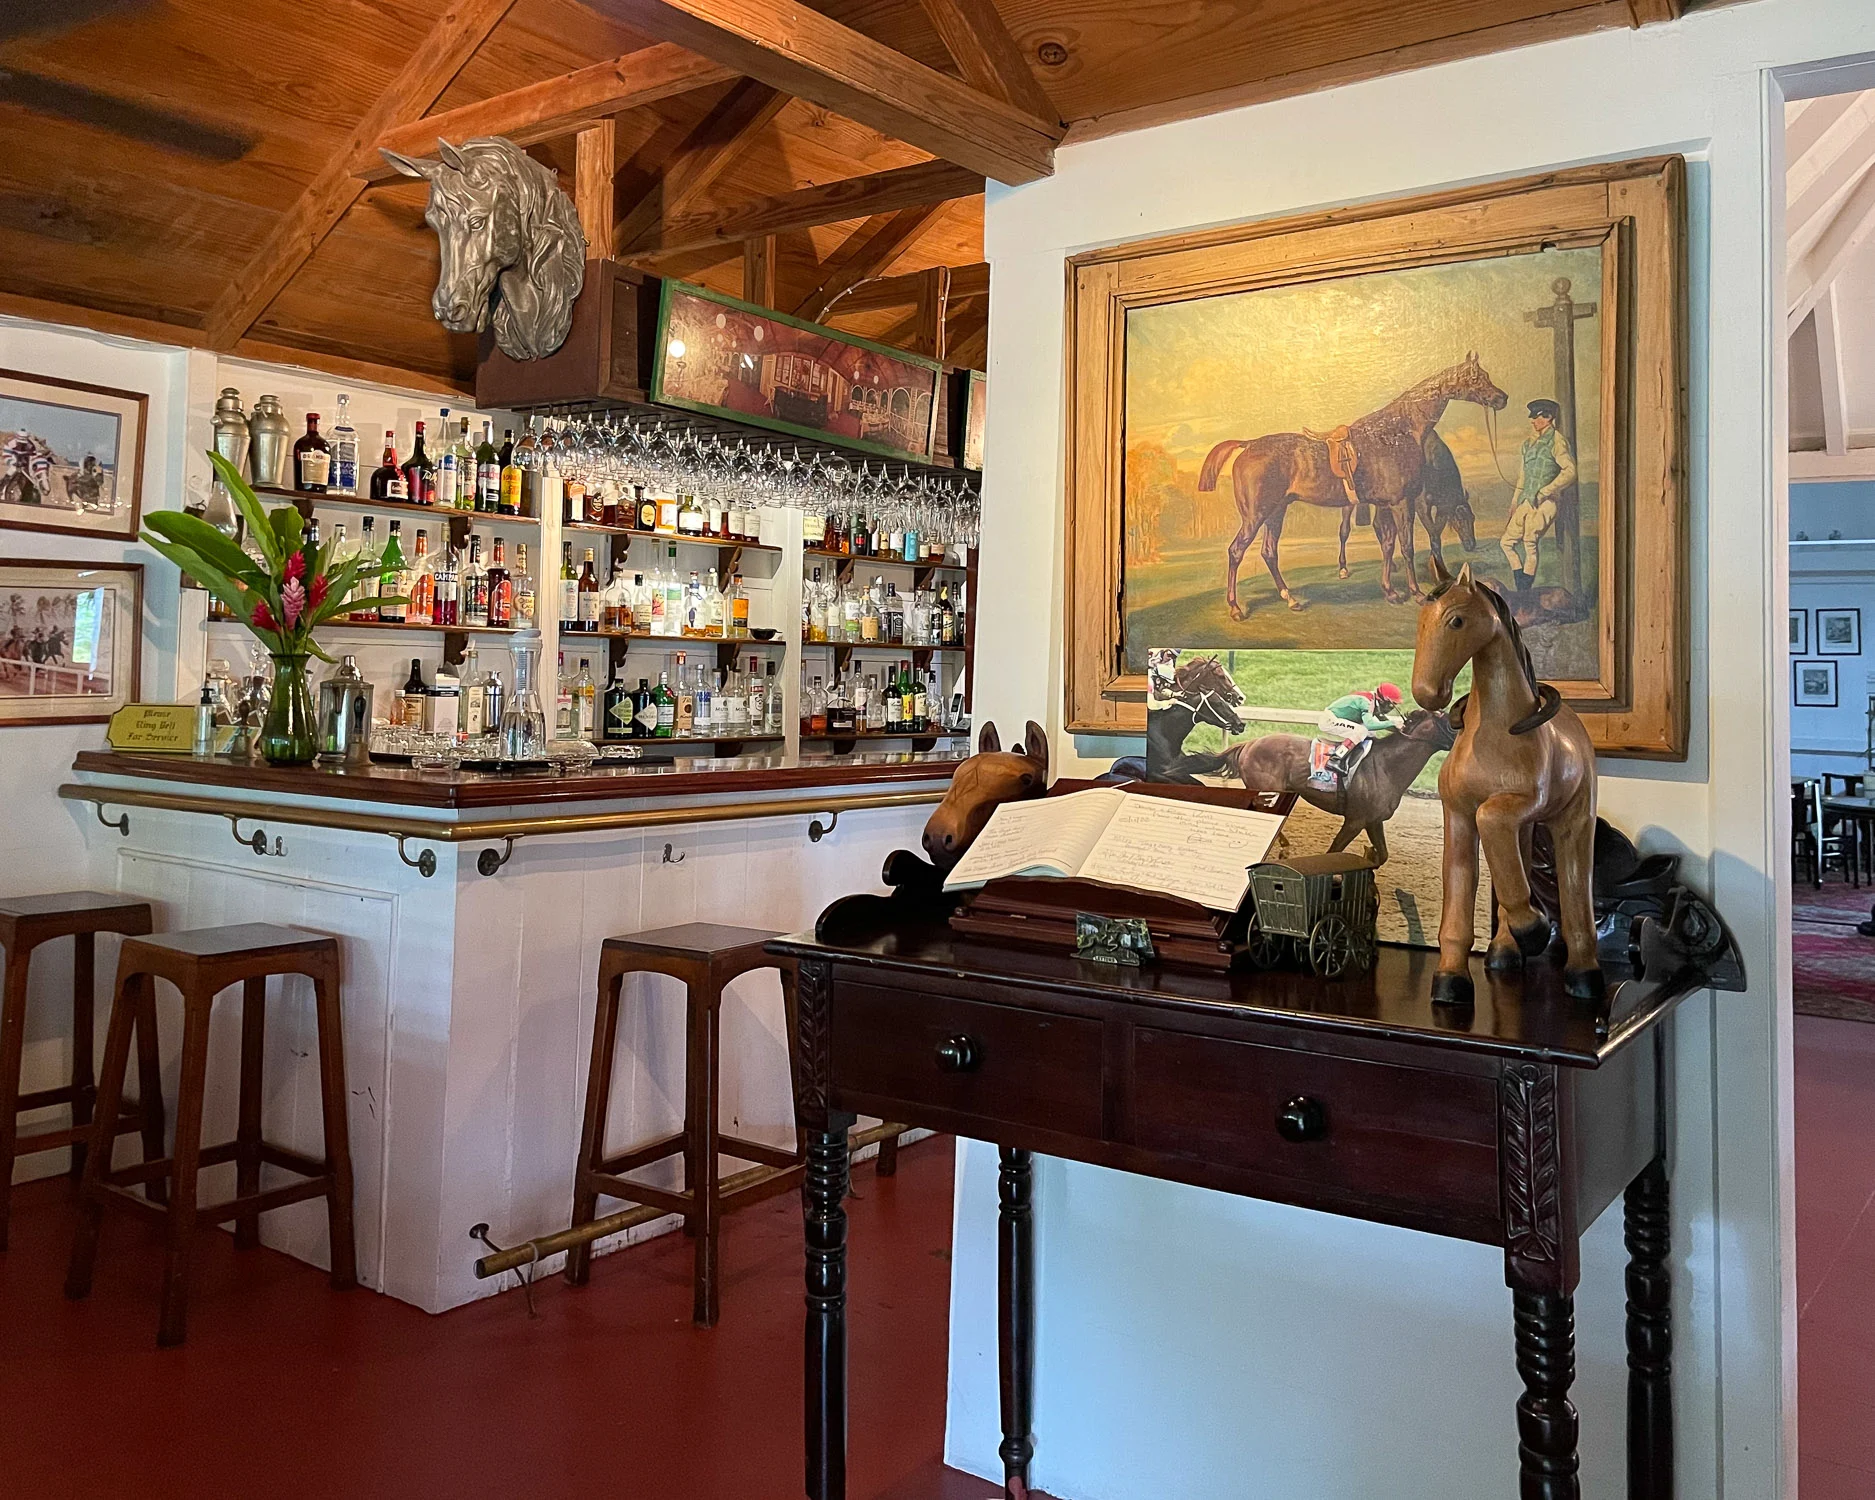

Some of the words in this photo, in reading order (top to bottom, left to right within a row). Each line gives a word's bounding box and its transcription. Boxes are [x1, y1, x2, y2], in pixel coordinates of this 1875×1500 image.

[144, 709, 171, 718] Please
[136, 720, 157, 731] Ring
[160, 721, 176, 730] Bell
[126, 732, 143, 741] For
